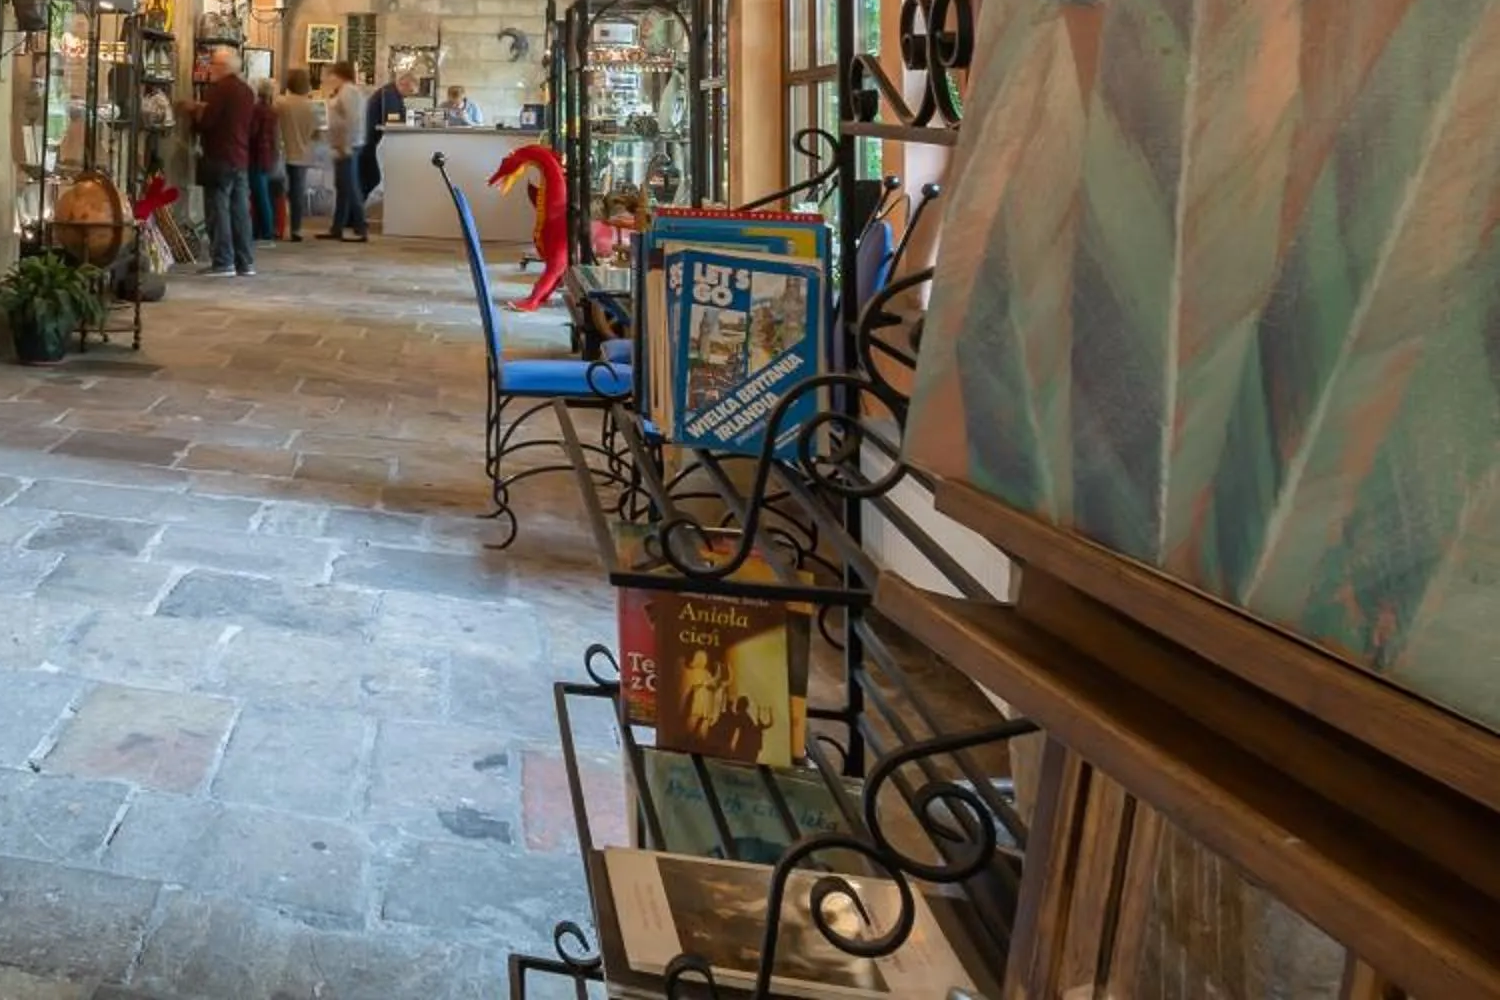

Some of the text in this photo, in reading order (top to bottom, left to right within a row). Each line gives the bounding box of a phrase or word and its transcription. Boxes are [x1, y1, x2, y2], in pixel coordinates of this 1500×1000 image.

[693, 283, 733, 305] GO
[687, 397, 741, 438] WIELKA
[736, 353, 804, 403] BRYTANIA
[713, 391, 780, 441] IRLANDIA
